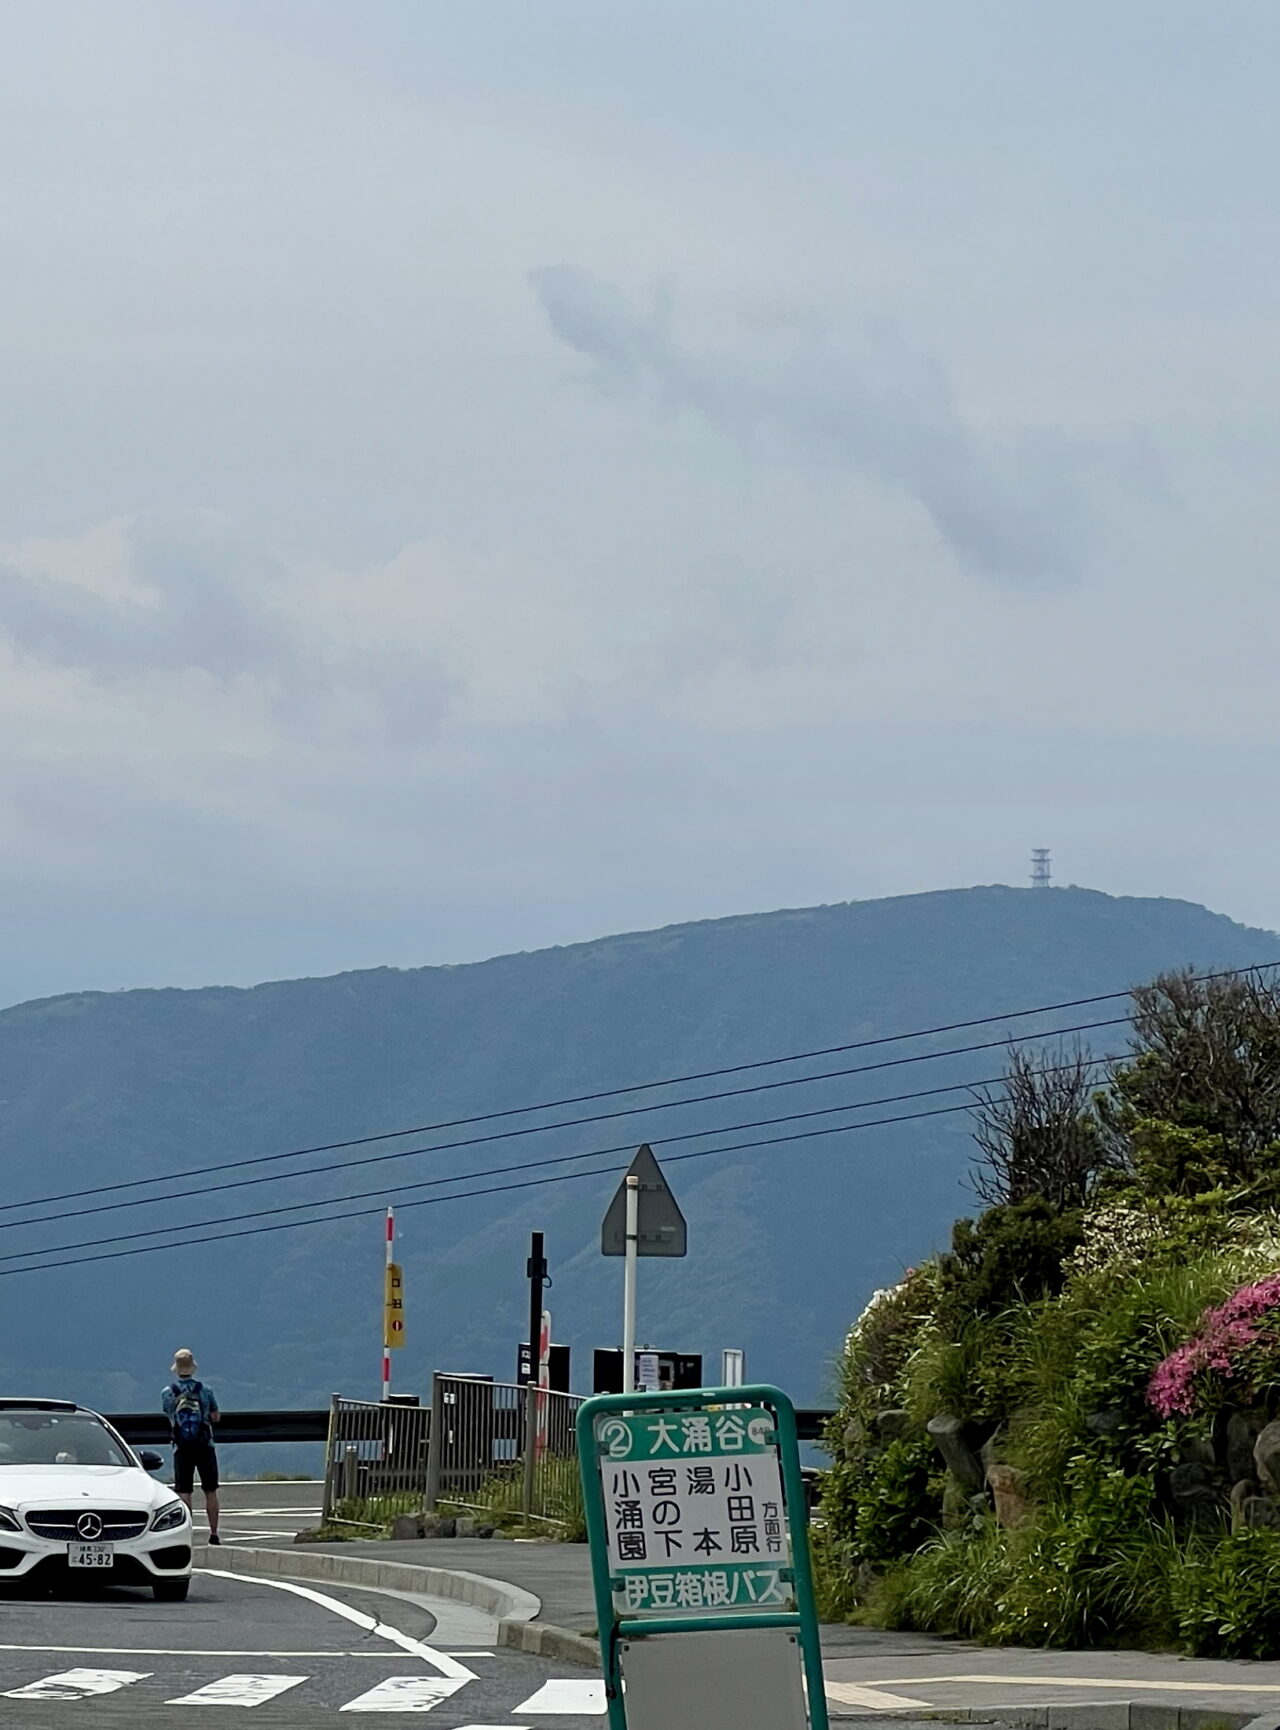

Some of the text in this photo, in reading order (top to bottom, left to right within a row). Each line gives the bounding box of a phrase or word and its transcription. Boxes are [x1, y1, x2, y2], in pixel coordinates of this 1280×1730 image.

[647, 1415, 746, 1454] 大涌谷
[612, 1470, 647, 1561] 小涌園
[648, 1467, 682, 1557] 宮の下
[686, 1466, 722, 1556] 湯本
[724, 1463, 760, 1554] 小田原
[761, 1501, 781, 1553] 方面行
[624, 1570, 782, 1611] 伊豆箱根バス
